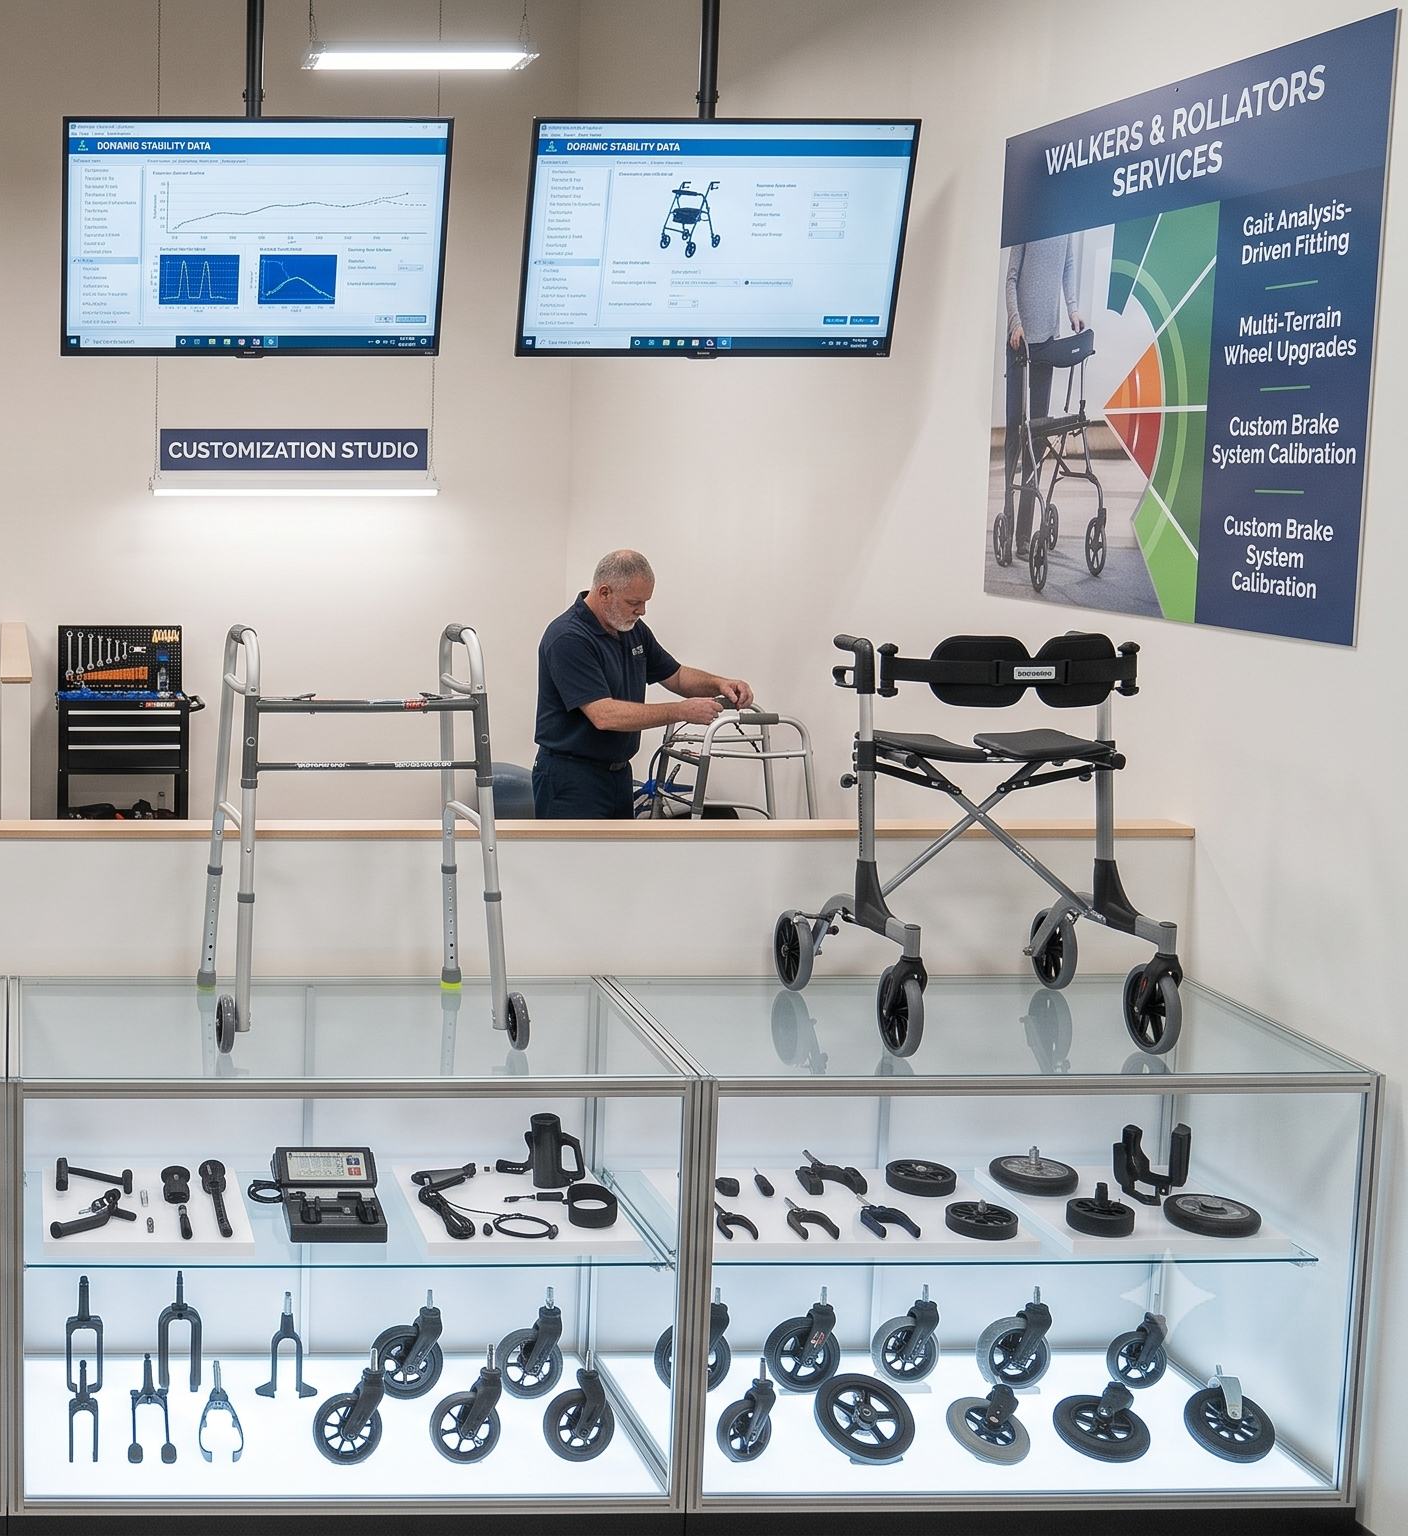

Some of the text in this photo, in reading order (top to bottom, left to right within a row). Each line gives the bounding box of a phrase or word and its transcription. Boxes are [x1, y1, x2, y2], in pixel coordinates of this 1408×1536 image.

[1045, 64, 1326, 175] WALKERS & ROLLATORS
[187, 141, 211, 150] DATA
[610, 142, 655, 151] STABILITY
[656, 142, 681, 151] DATA
[1112, 141, 1224, 197] SERVICES
[1242, 199, 1352, 237] Gait Analysis-
[1241, 230, 1350, 266] Driven Fitting
[1239, 306, 1342, 337] Multi-Terrain
[1224, 336, 1357, 366] Wheel Upgrades
[1229, 413, 1340, 437] Custom Brake
[168, 441, 419, 459] CUSTOMIZATION STUDIO
[1211, 442, 1357, 470] System Calibration
[1223, 515, 1334, 542] Custom Brake
[1246, 544, 1304, 570] System
[1231, 571, 1317, 600] Calibration
